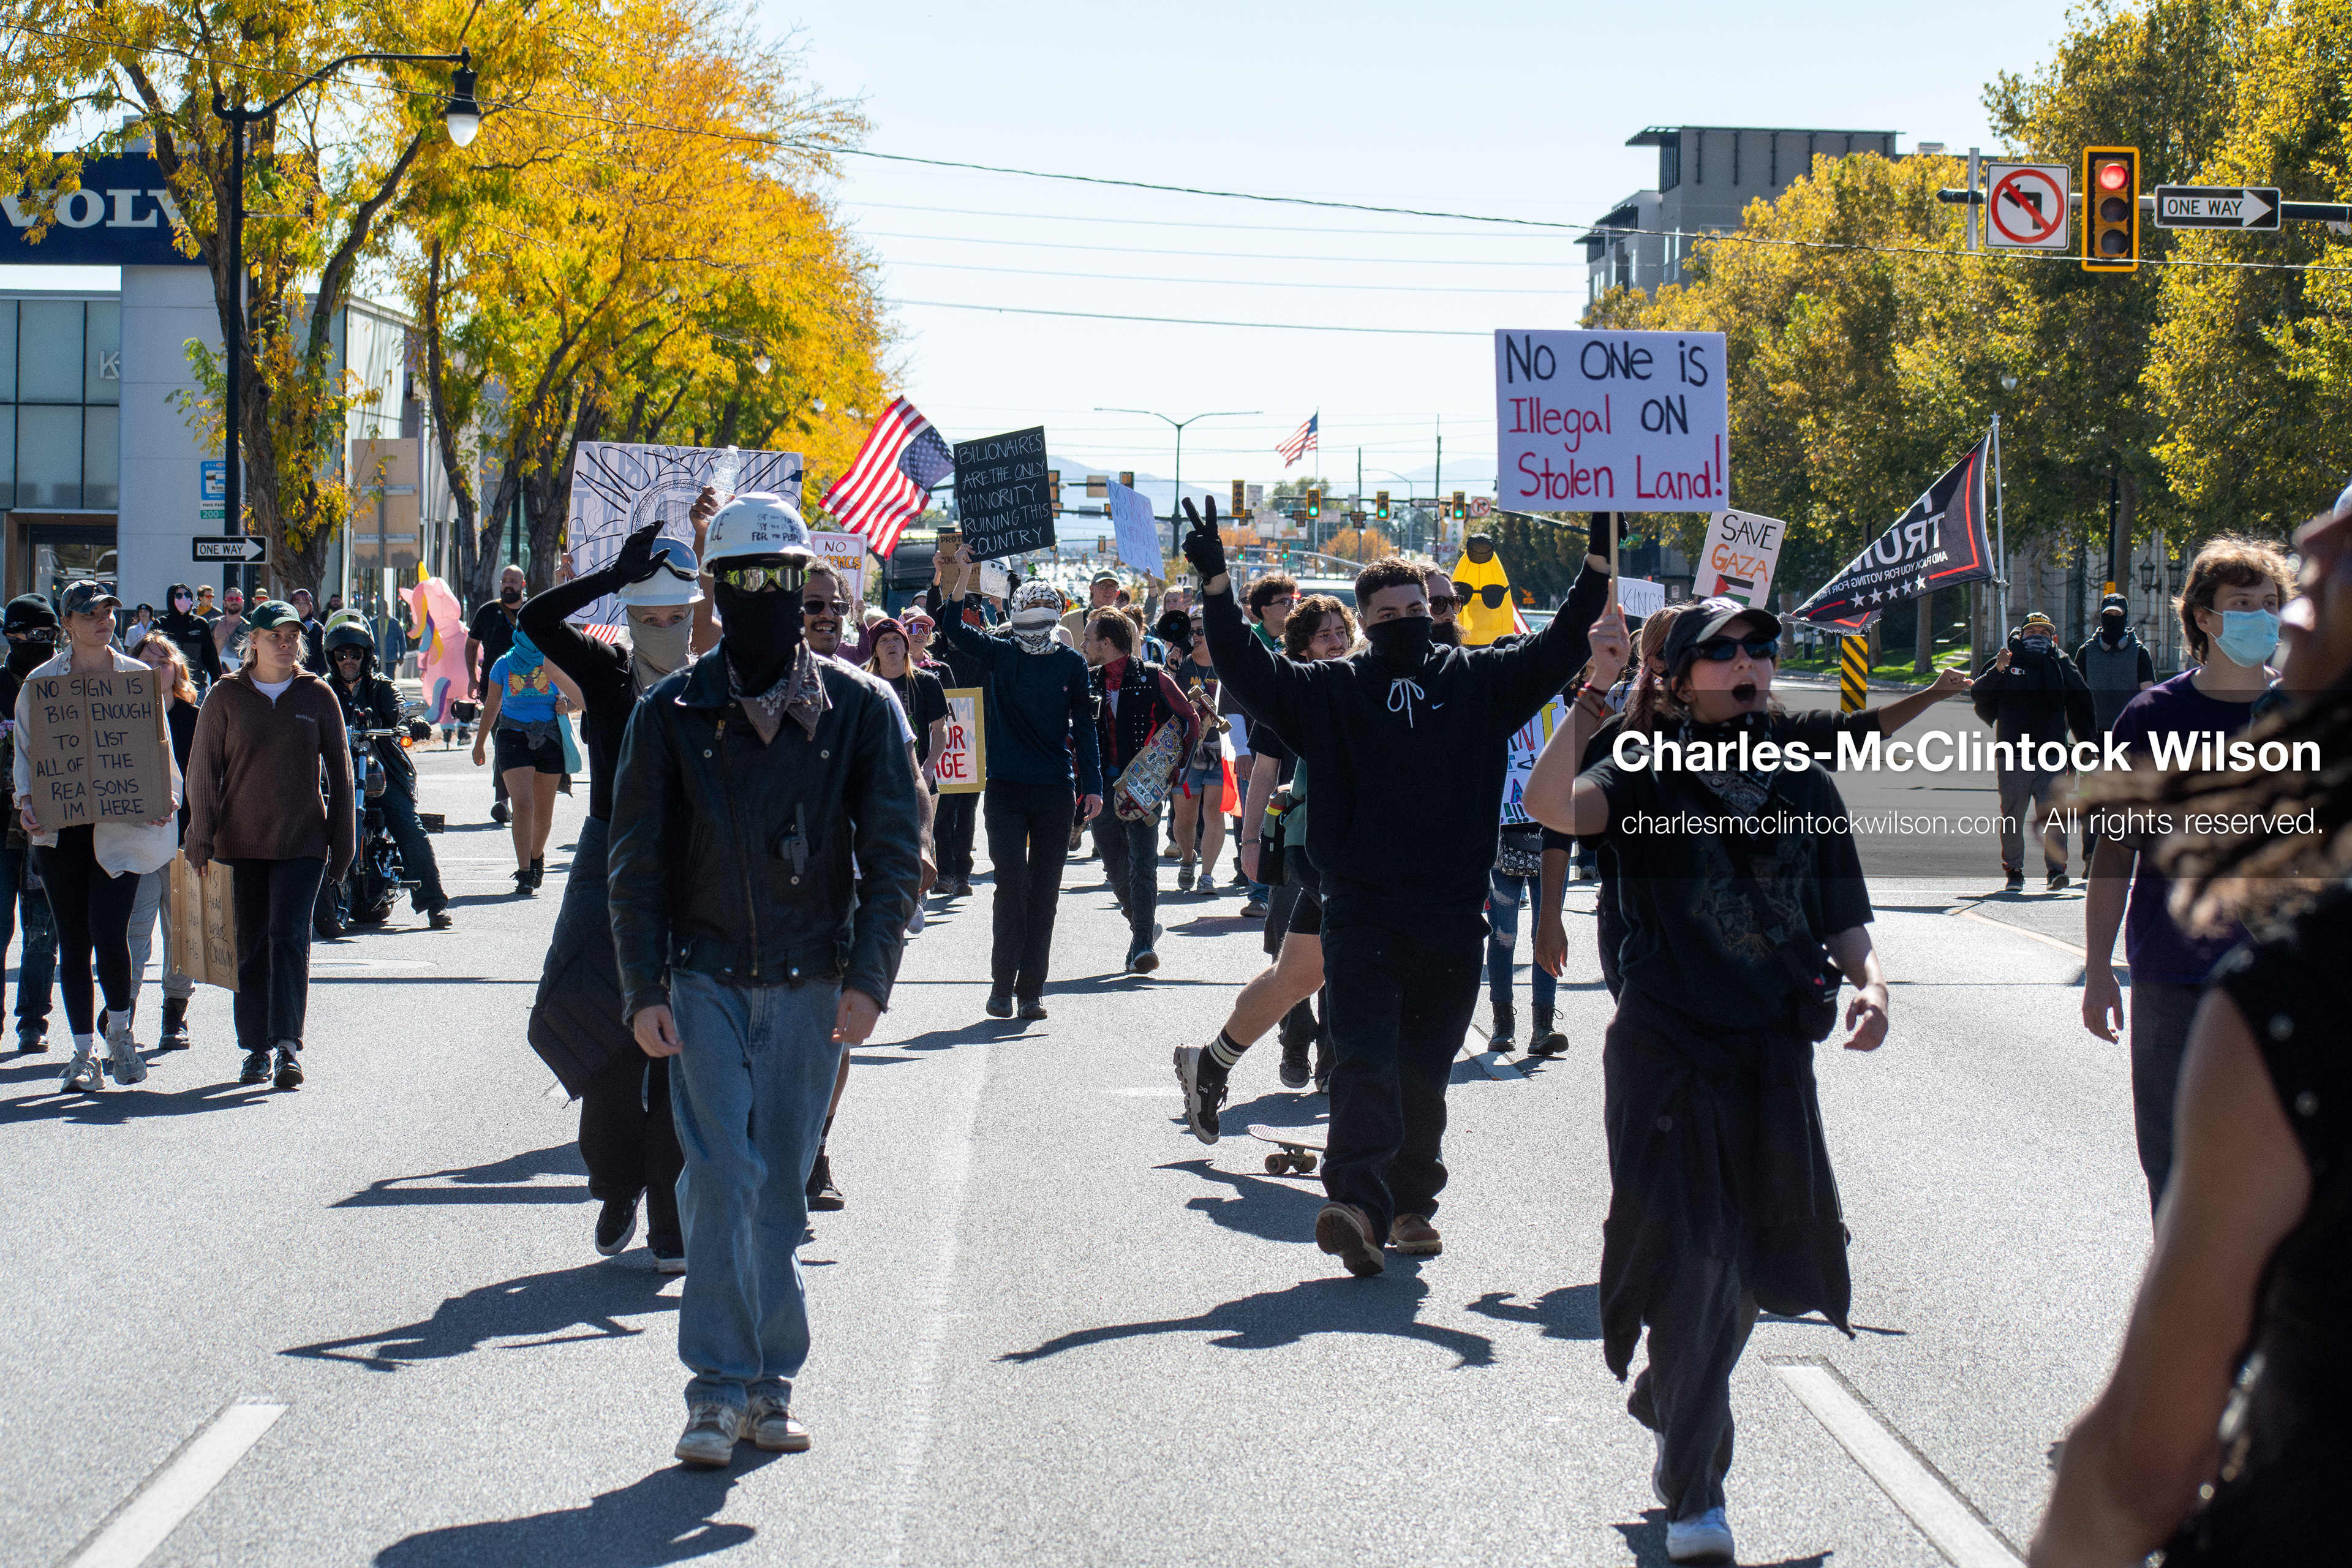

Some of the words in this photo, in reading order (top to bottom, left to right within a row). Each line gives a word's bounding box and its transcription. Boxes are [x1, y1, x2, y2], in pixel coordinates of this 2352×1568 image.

[2168, 199, 2200, 214] ONE
[2208, 200, 2242, 216] WAY
[1506, 334, 1556, 383] No
[1509, 394, 1611, 453] Illegal
[1641, 394, 1689, 434] ON
[963, 471, 990, 490] ARE
[989, 467, 1011, 483] THE
[1015, 460, 1045, 479] ONLY
[1518, 451, 1613, 500] Stolen
[1637, 434, 1722, 500] Land!
[962, 483, 1036, 513] MINORITY
[1109, 482, 1126, 505] NO
[963, 510, 1019, 535] RUINING
[1020, 503, 1049, 522] THIS
[1112, 502, 1128, 521] NO
[969, 527, 1041, 555] COUNTRY
[1721, 514, 1776, 550] SAVE
[200, 545, 219, 554] ONE
[223, 545, 243, 554] WAY
[824, 541, 846, 552] NO
[817, 554, 862, 570] INGS
[1711, 543, 1768, 582] GAZA
[36, 680, 59, 700] NO
[70, 678, 112, 697] SIGN
[126, 678, 143, 695] IS
[44, 705, 78, 723] BIG
[92, 701, 151, 721] ENOUGH
[53, 734, 80, 750] TO
[94, 730, 128, 747] LIST
[37, 758, 64, 777] ALL
[67, 757, 85, 772] OF
[98, 753, 134, 769] THE
[63, 802, 85, 820] IM
[100, 799, 145, 816] HERE
